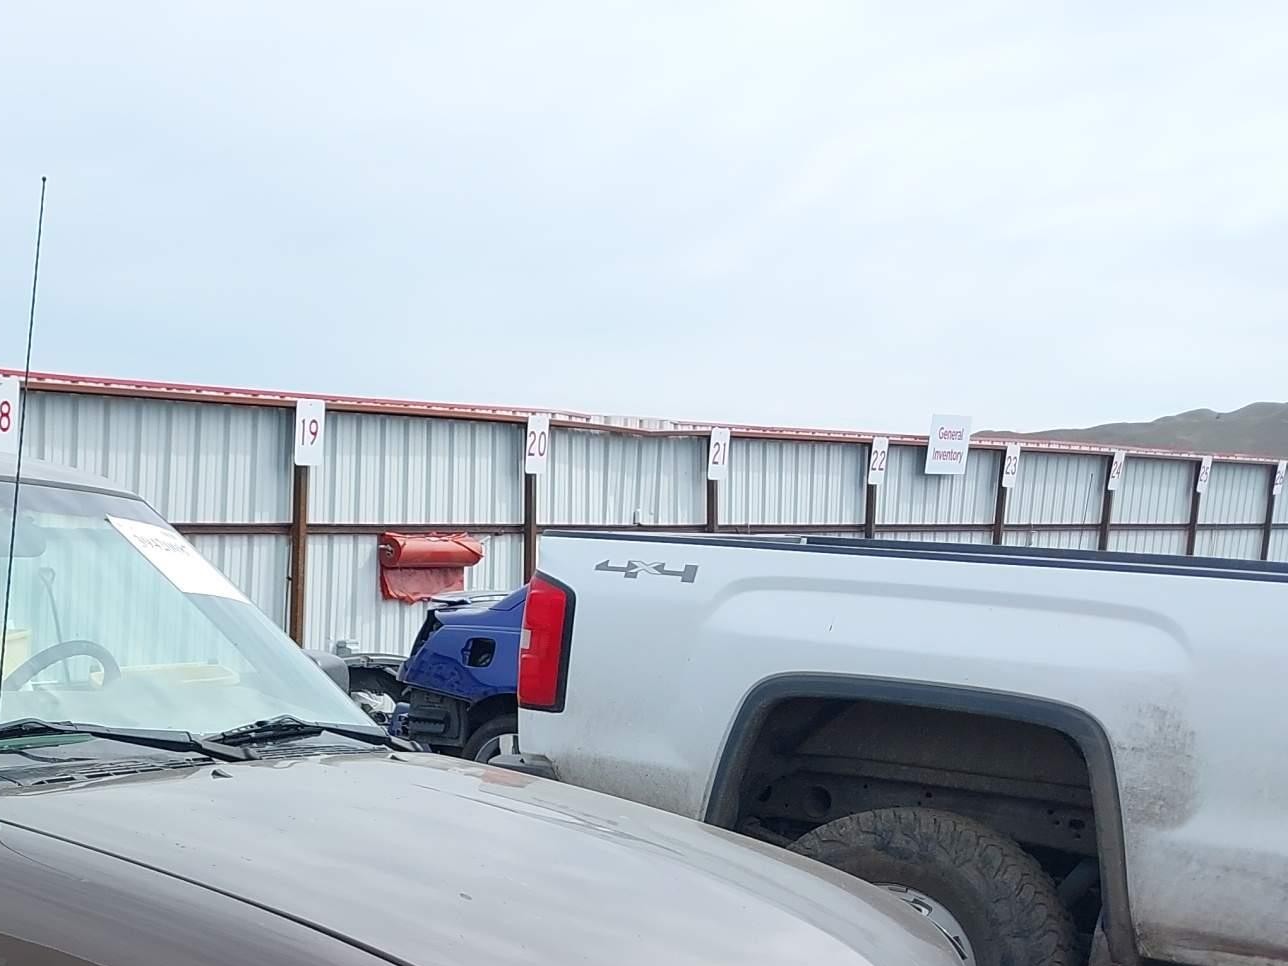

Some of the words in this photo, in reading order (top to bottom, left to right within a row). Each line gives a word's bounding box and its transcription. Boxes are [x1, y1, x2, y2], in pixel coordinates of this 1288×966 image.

[301, 418, 319, 446] 19
[937, 426, 964, 441] General
[527, 430, 547, 457] 20
[711, 441, 727, 465] 21
[871, 450, 887, 471] 22
[932, 447, 964, 464] Inventory
[1004, 456, 1017, 476] 23
[1111, 460, 1122, 479] 24
